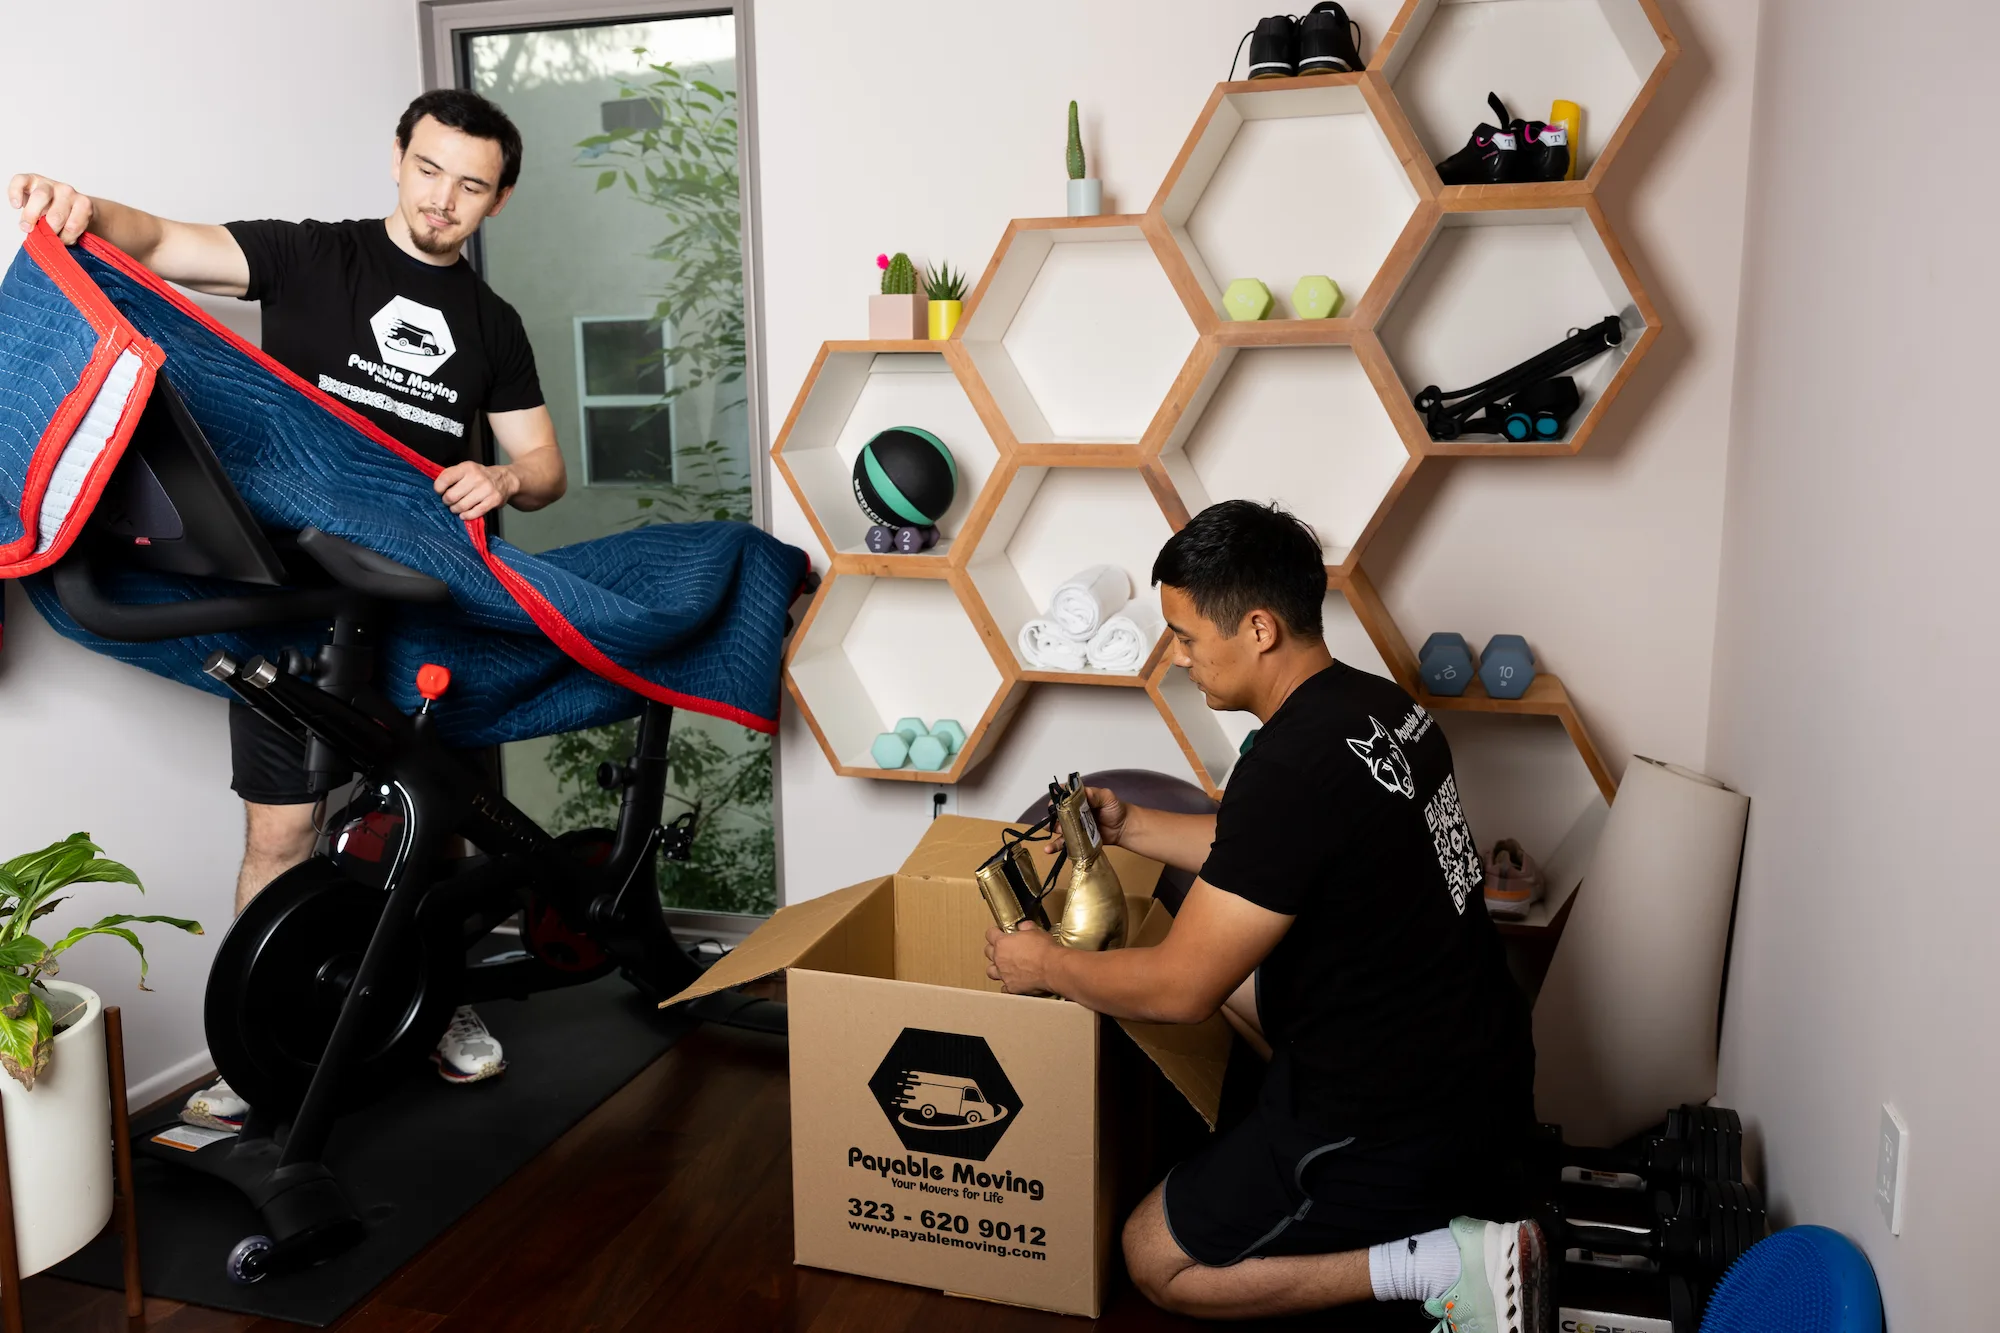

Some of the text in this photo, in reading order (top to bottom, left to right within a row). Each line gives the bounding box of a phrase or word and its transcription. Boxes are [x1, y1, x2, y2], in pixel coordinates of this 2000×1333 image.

[348, 354, 458, 404] Payable Moving
[386, 380, 410, 394] Movers
[410, 387, 421, 397] for
[421, 392, 434, 401] Life
[874, 530, 881, 541] 2
[903, 531, 910, 542] 2
[1442, 664, 1457, 680] 10
[1499, 665, 1514, 679] 10
[848, 1147, 1044, 1201] Payable Moving
[891, 1177, 1004, 1204] Your Movers for Life
[848, 1198, 895, 1222] 323
[920, 1209, 969, 1234] 620
[978, 1218, 1047, 1247] 9012
[848, 1220, 1046, 1261] www.payablemoving.com
